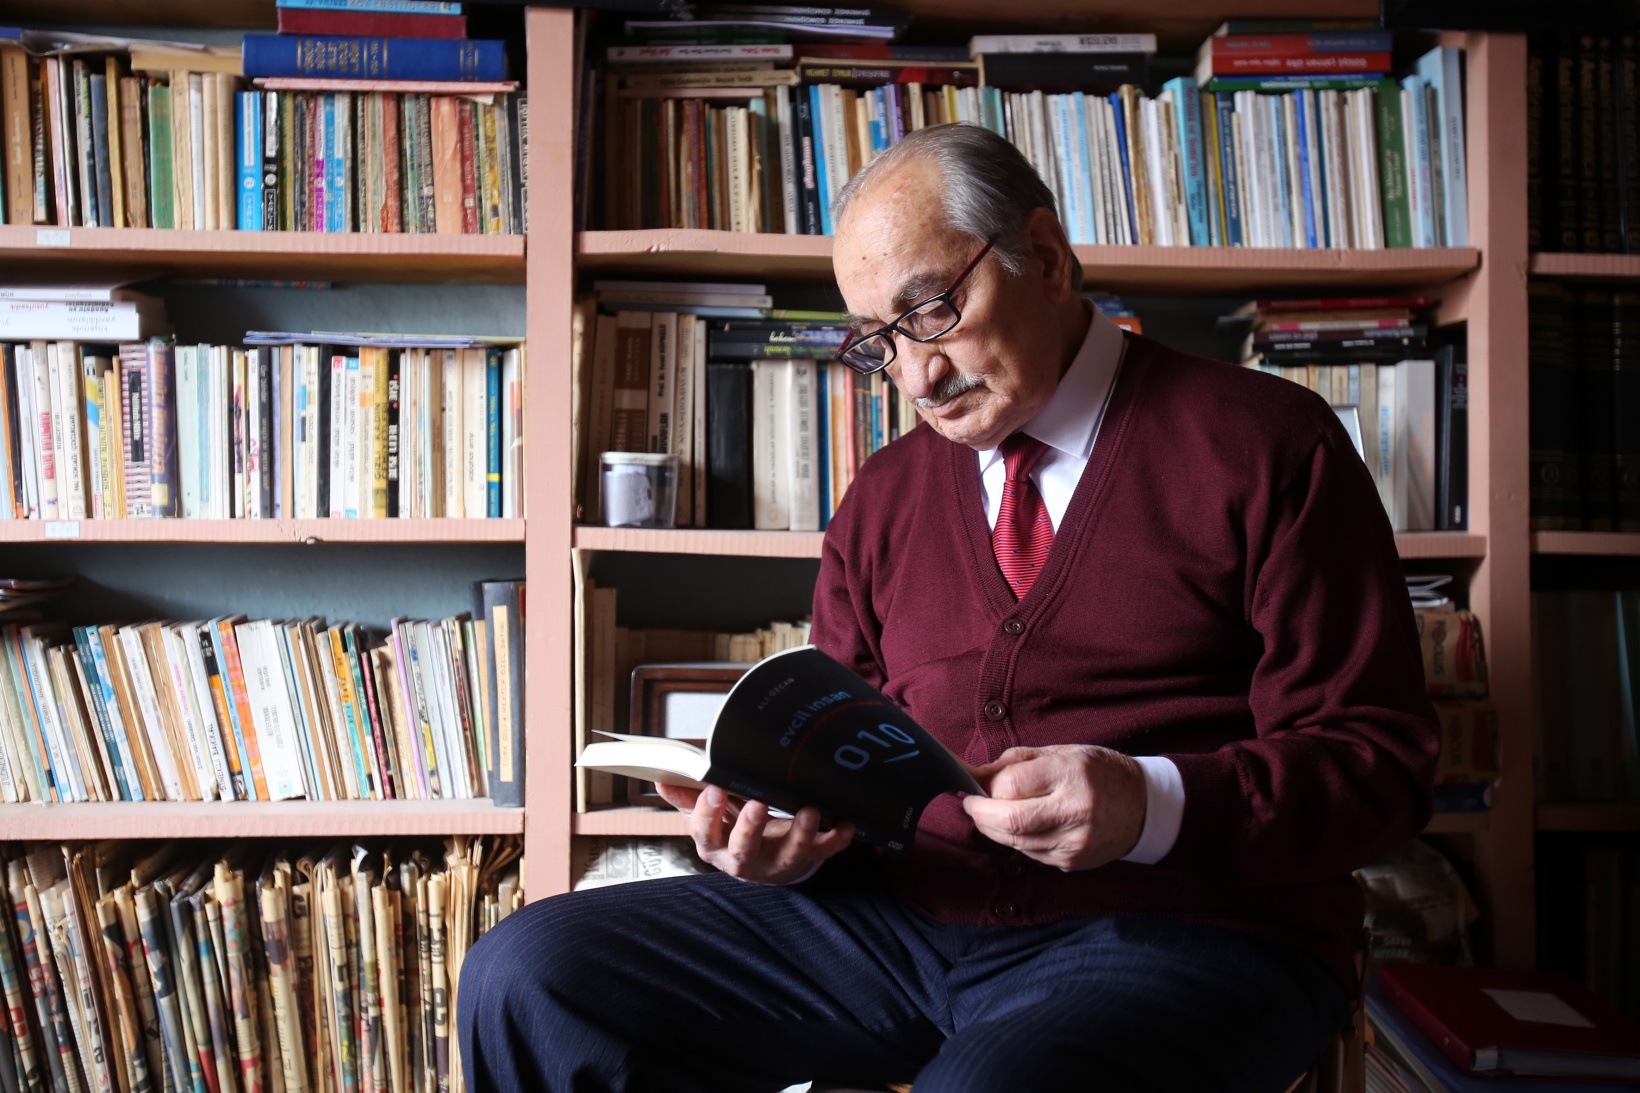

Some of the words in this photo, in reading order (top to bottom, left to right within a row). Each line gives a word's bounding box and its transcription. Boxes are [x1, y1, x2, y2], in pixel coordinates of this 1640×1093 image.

[1430, 619, 1447, 677] FOCUS
[778, 709, 812, 748] evcil
[808, 689, 853, 712] insan
